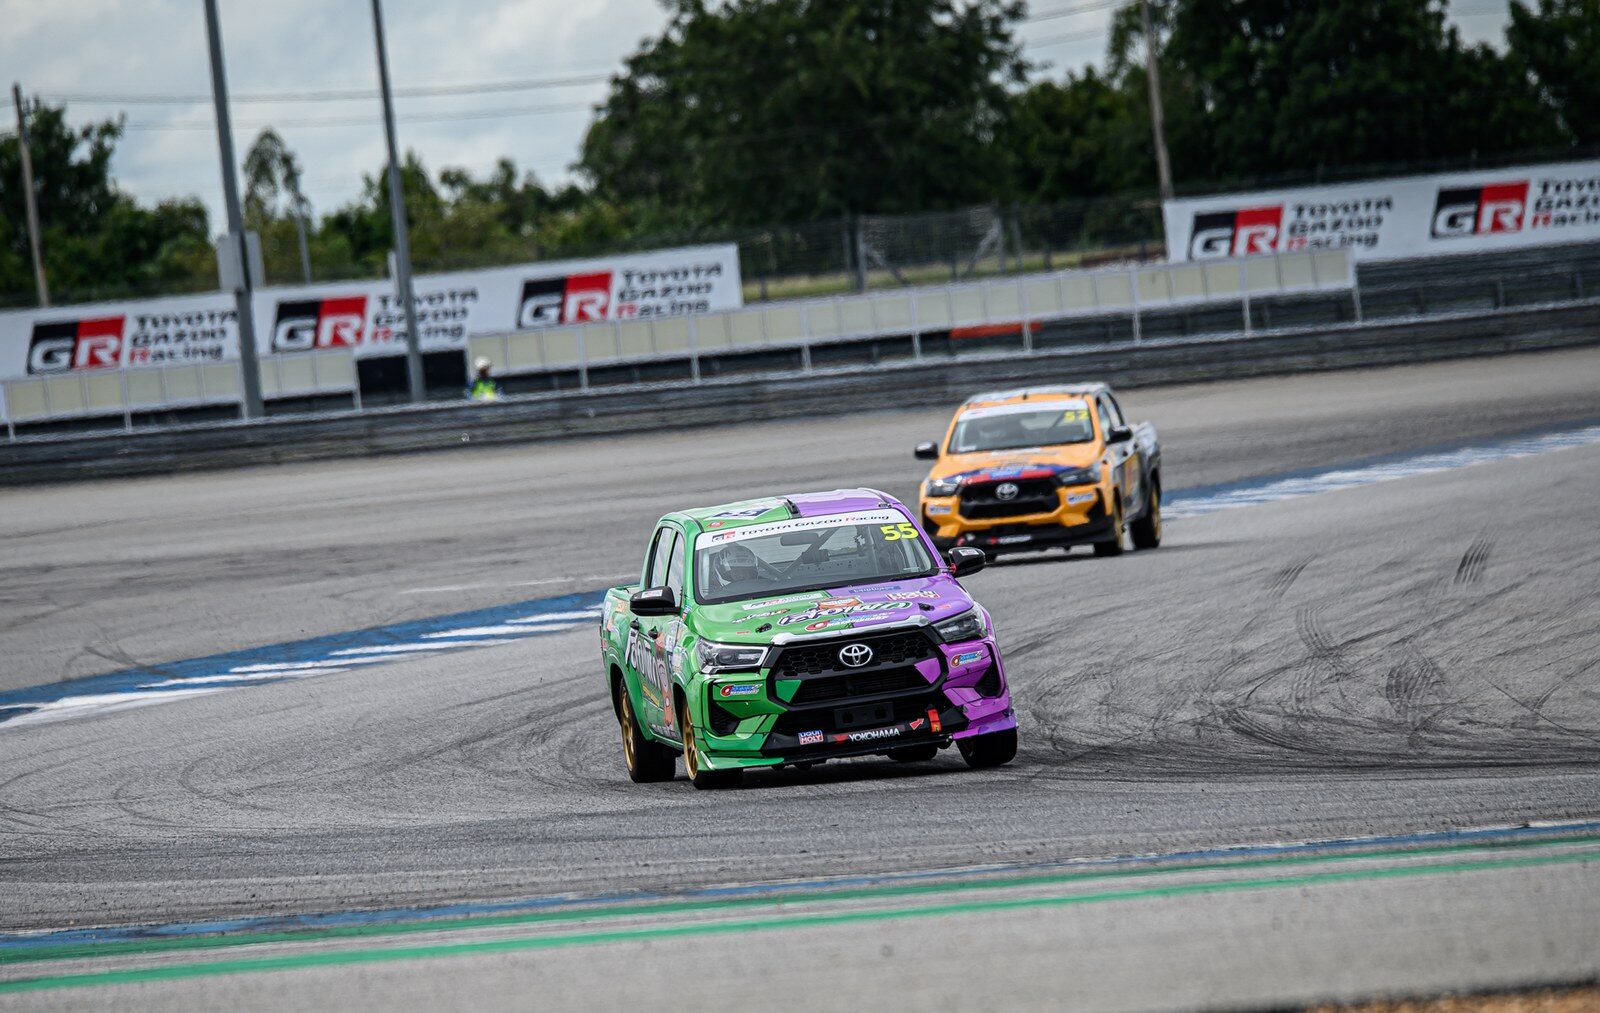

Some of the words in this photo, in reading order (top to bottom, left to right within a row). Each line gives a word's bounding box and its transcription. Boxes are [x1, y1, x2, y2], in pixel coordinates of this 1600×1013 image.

[1294, 196, 1392, 218] TOYOTA
[1288, 215, 1383, 236] GAZOO
[1434, 200, 1524, 238] GR
[1191, 224, 1277, 258] GR
[624, 263, 722, 286] TOYOTA
[618, 282, 712, 302] GAZOO
[521, 294, 612, 327] GR
[131, 327, 226, 347] GAZOO
[275, 314, 365, 349] GR
[30, 335, 121, 373] GR
[129, 343, 223, 363] Racing
[740, 524, 791, 536] TOYOTA
[795, 517, 841, 527] GAZOO
[845, 514, 890, 524] Racing
[879, 522, 920, 541] 55
[799, 730, 821, 738] LIQUI
[801, 735, 823, 744] MOLY
[849, 728, 900, 742] YOKOHAMA
